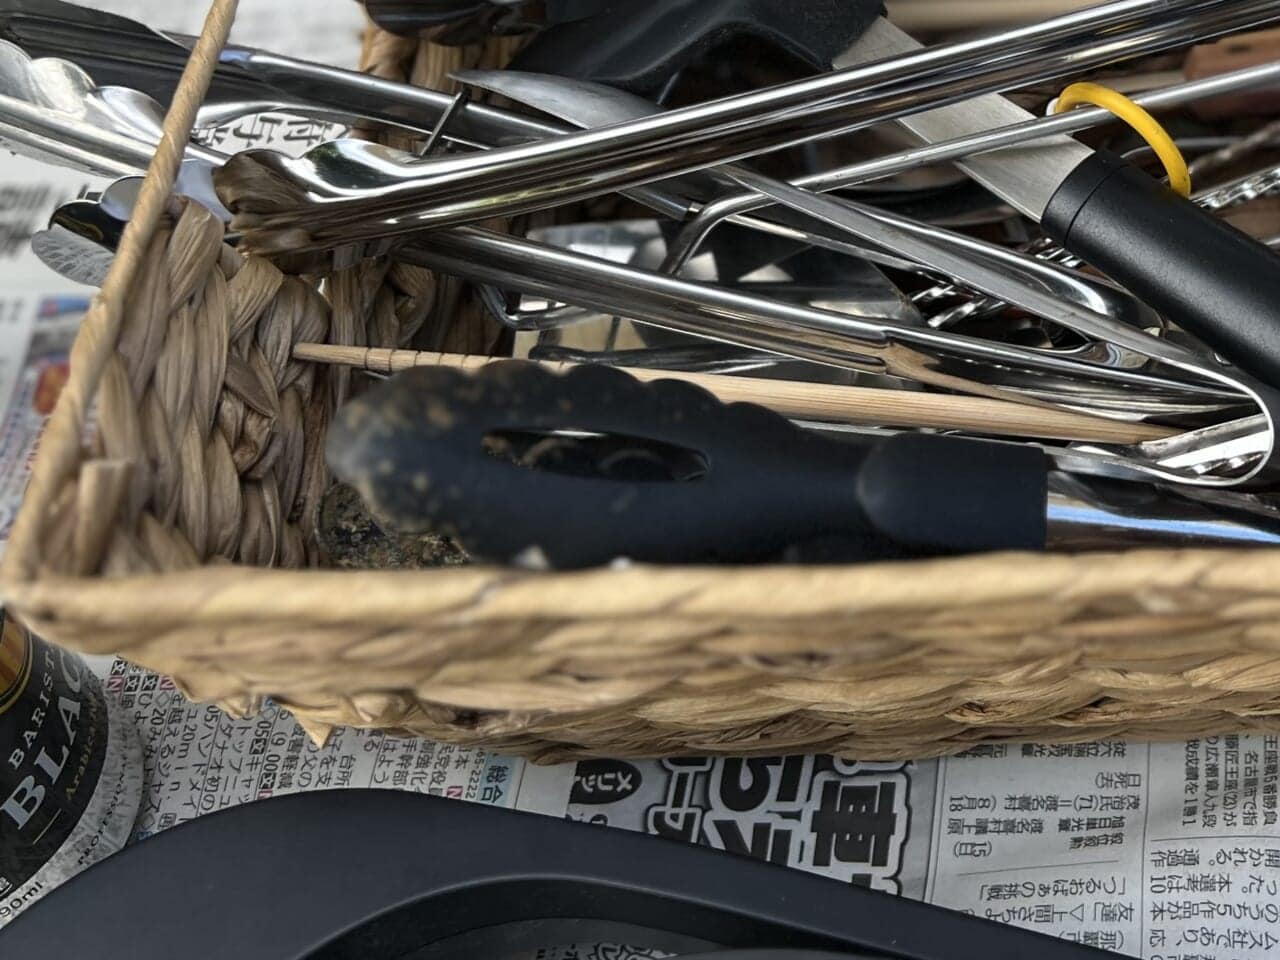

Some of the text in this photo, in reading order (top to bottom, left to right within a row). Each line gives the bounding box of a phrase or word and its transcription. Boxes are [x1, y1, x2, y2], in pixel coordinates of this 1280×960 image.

[334, 754, 356, 787] 台所
[465, 749, 484, 799] 65-2222
[575, 771, 632, 793] メリッ
[1095, 772, 1141, 789] 日死去）
[953, 841, 992, 858] （15日）
[980, 876, 1124, 900] 「つるおばぁの挑戦」
